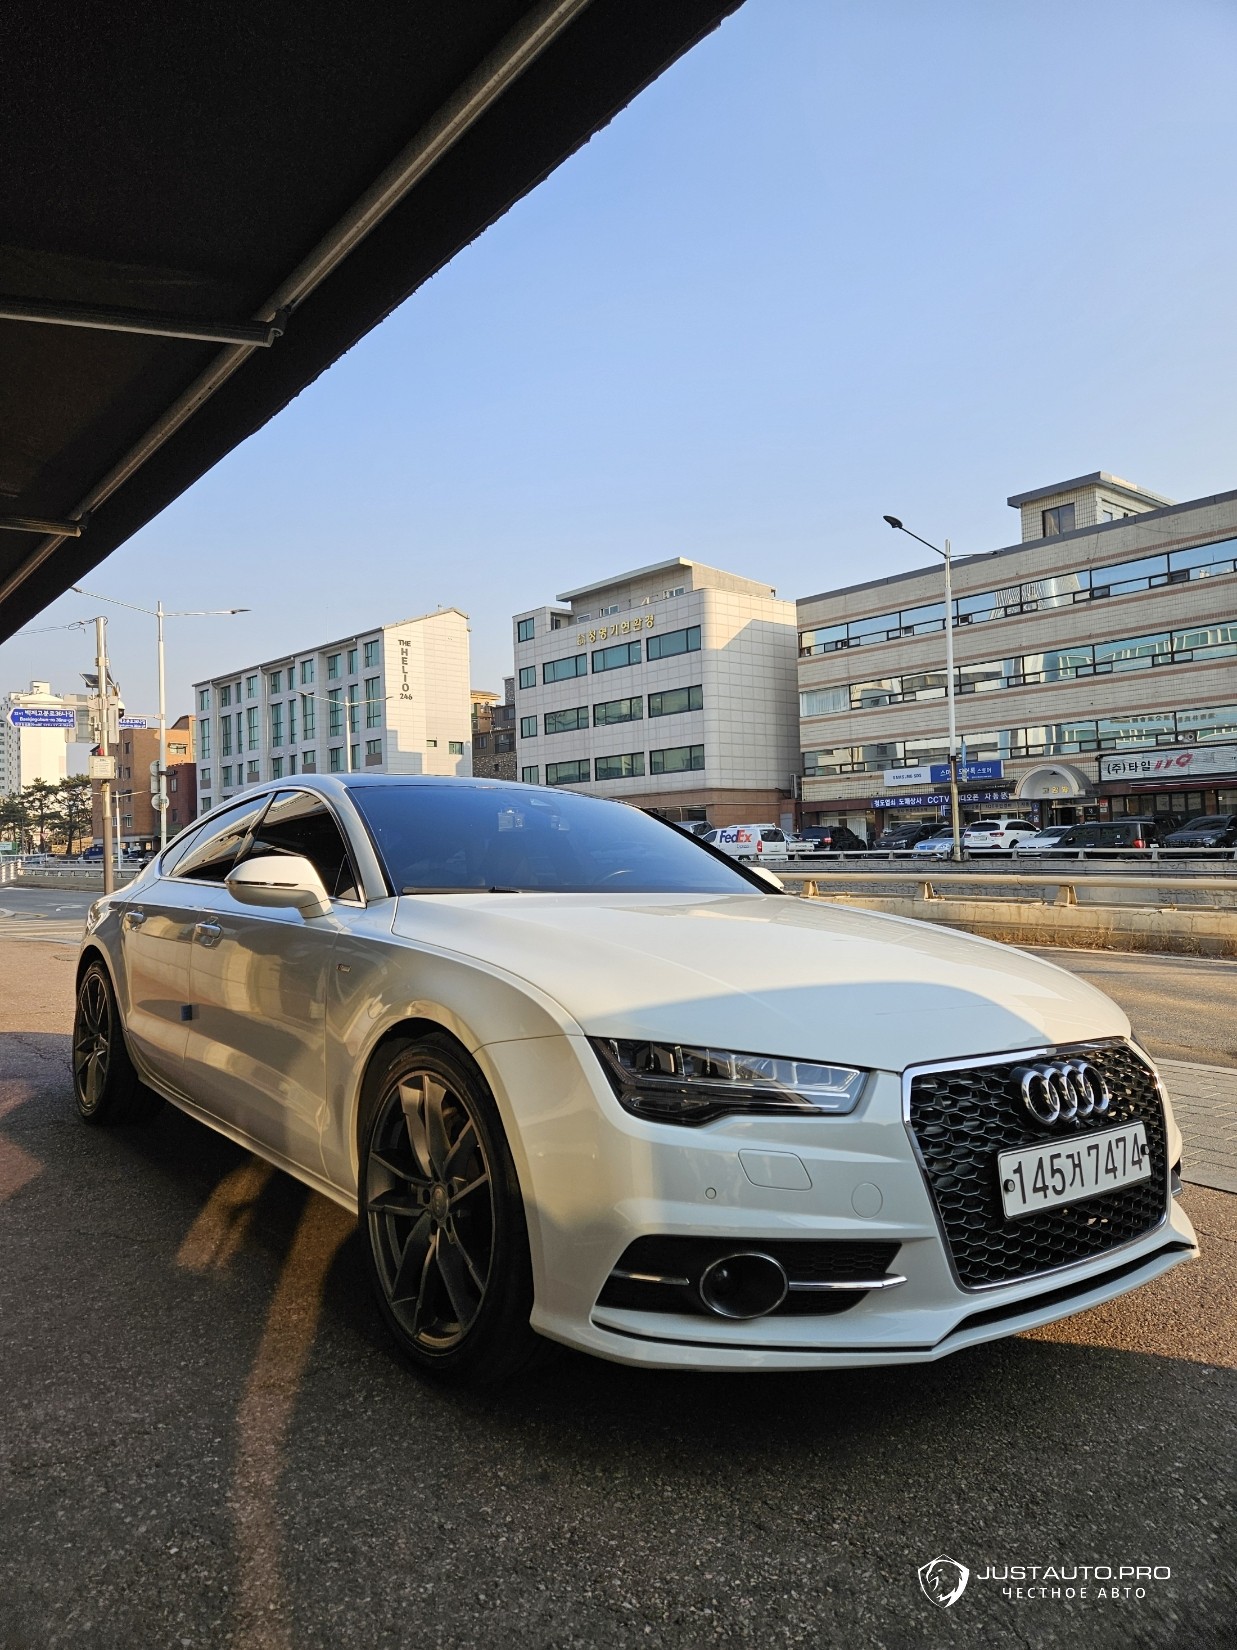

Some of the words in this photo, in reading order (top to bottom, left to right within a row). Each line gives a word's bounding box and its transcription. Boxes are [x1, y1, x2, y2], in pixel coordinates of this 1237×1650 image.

[398, 639, 411, 647] THE
[401, 648, 409, 692] HELIO
[927, 795, 950, 804] CCTV
[720, 829, 752, 844] FedEx
